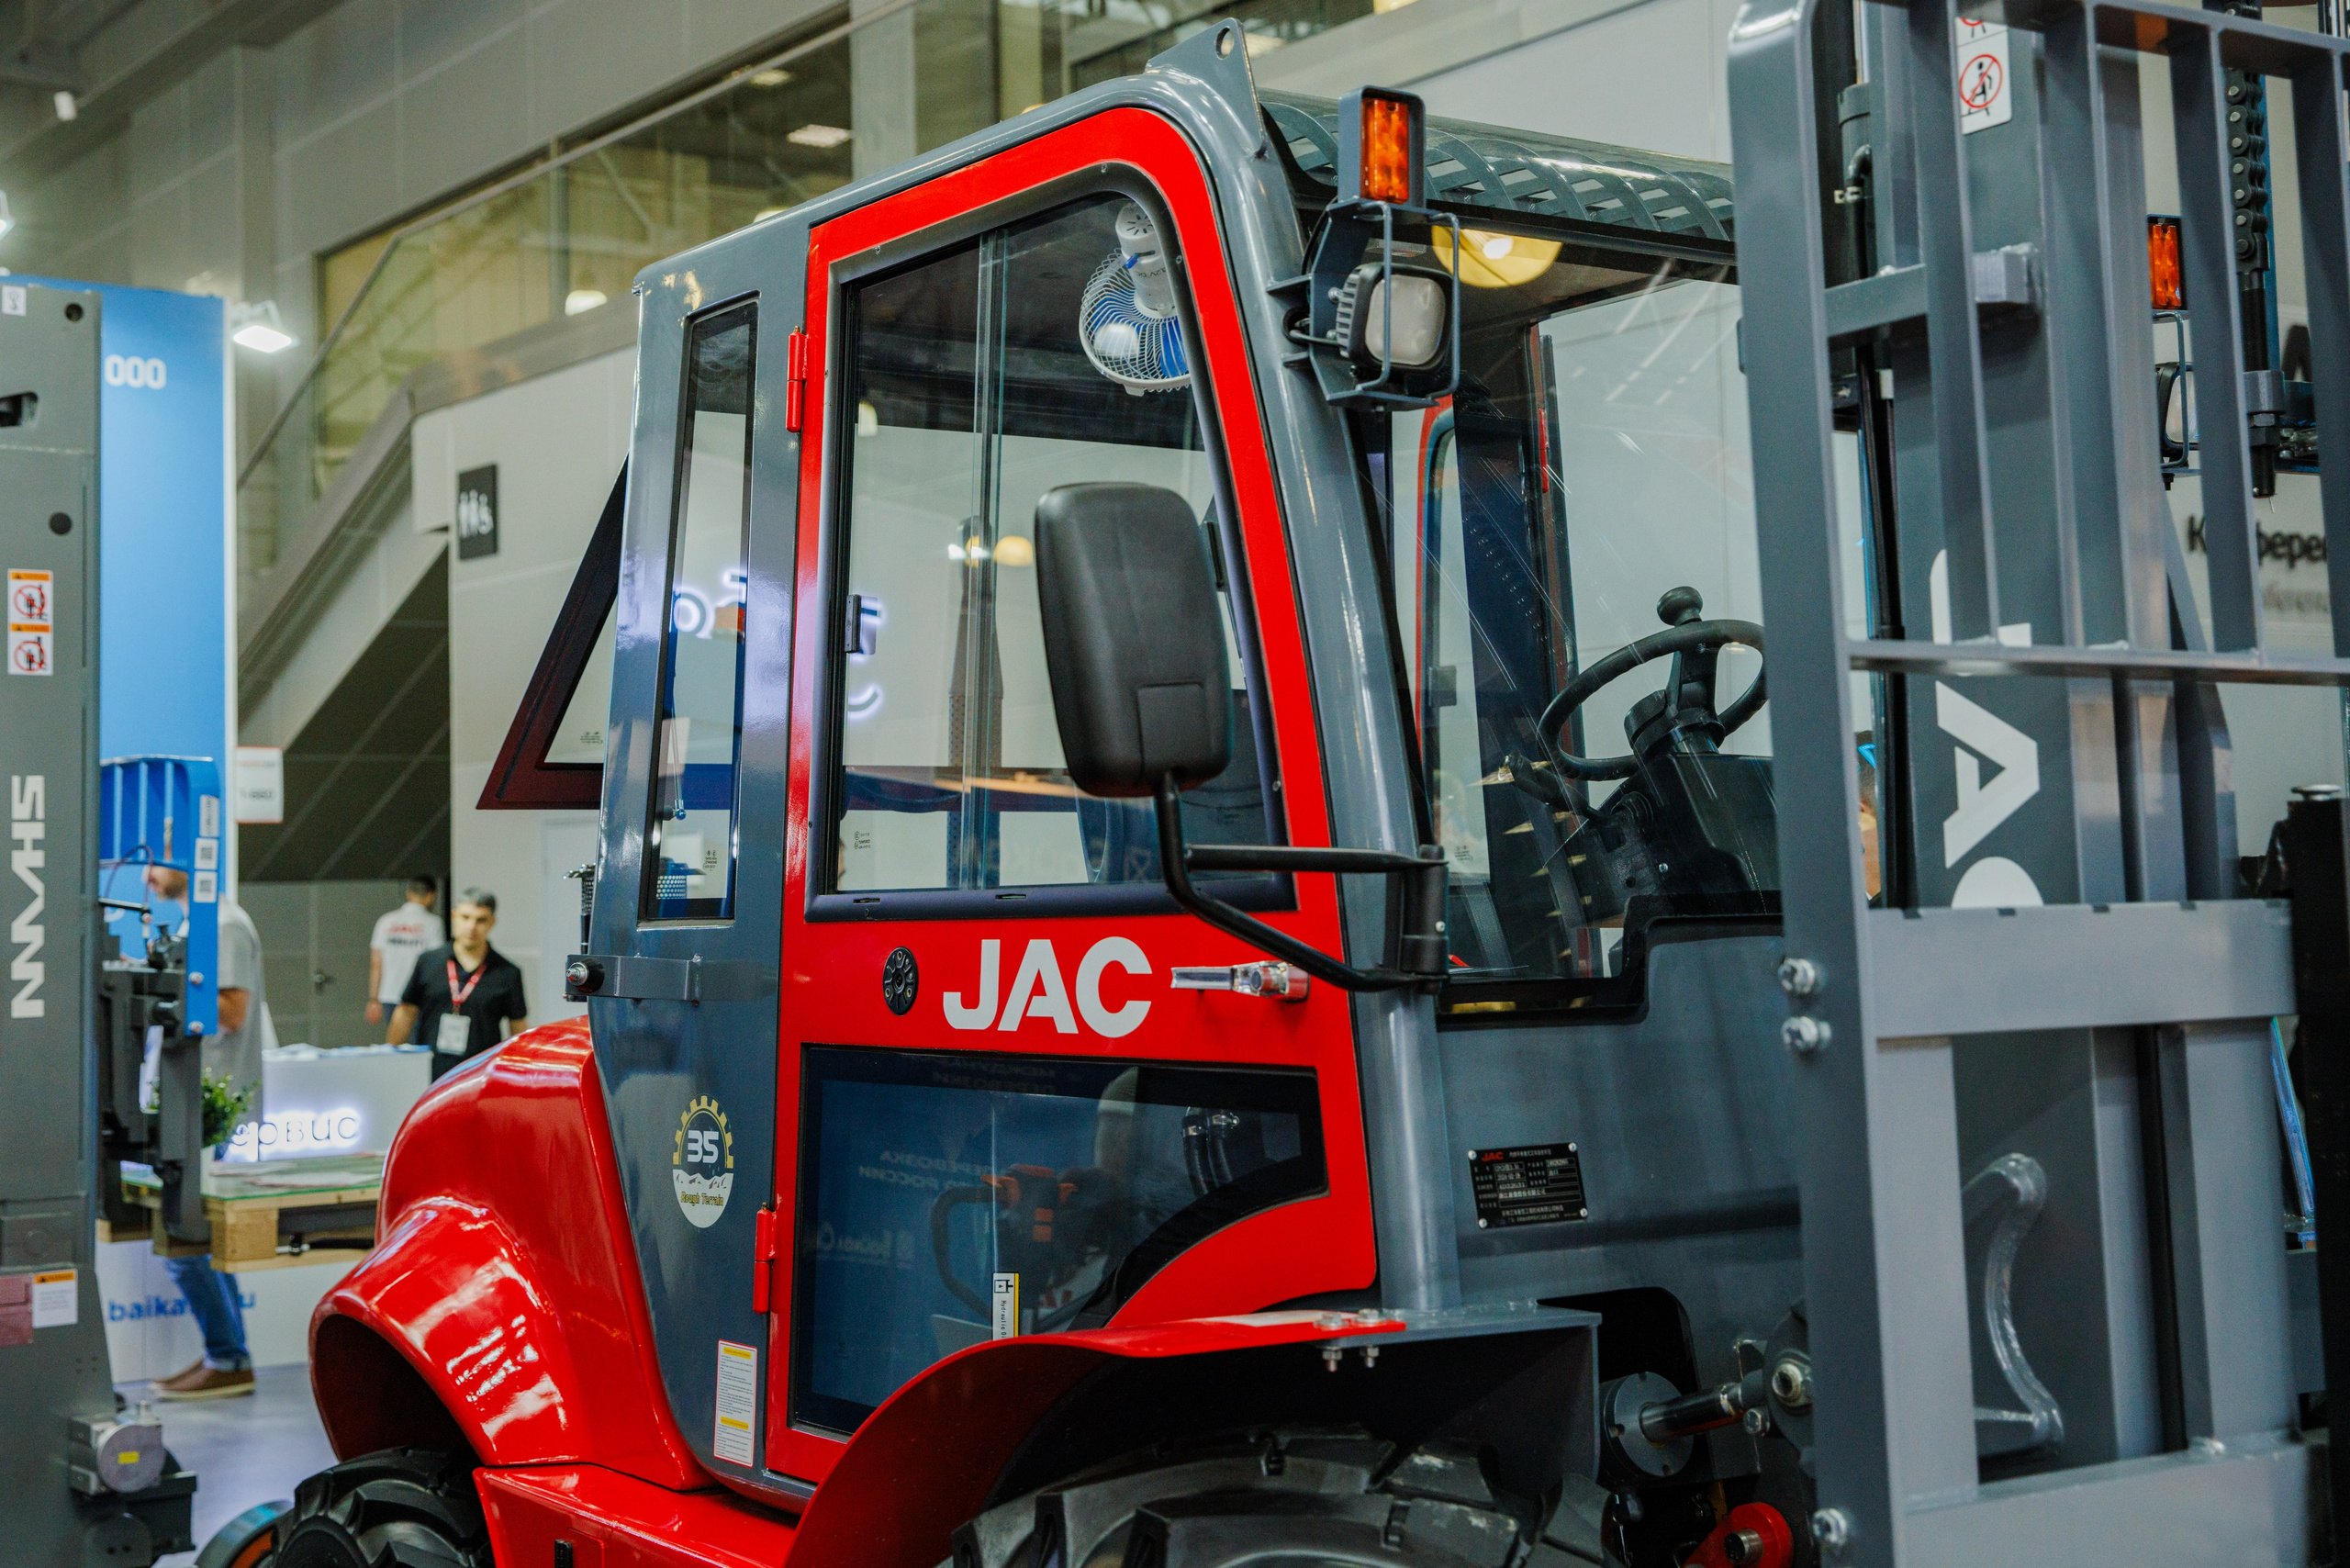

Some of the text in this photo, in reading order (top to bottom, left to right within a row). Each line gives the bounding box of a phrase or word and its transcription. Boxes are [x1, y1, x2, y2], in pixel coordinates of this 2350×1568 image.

[943, 936, 1153, 1037] JAC
[230, 1117, 358, 1161] ервис
[688, 1130, 719, 1163] 35
[1482, 1152, 1504, 1161] JAC
[680, 1191, 723, 1206] Rough Terrain
